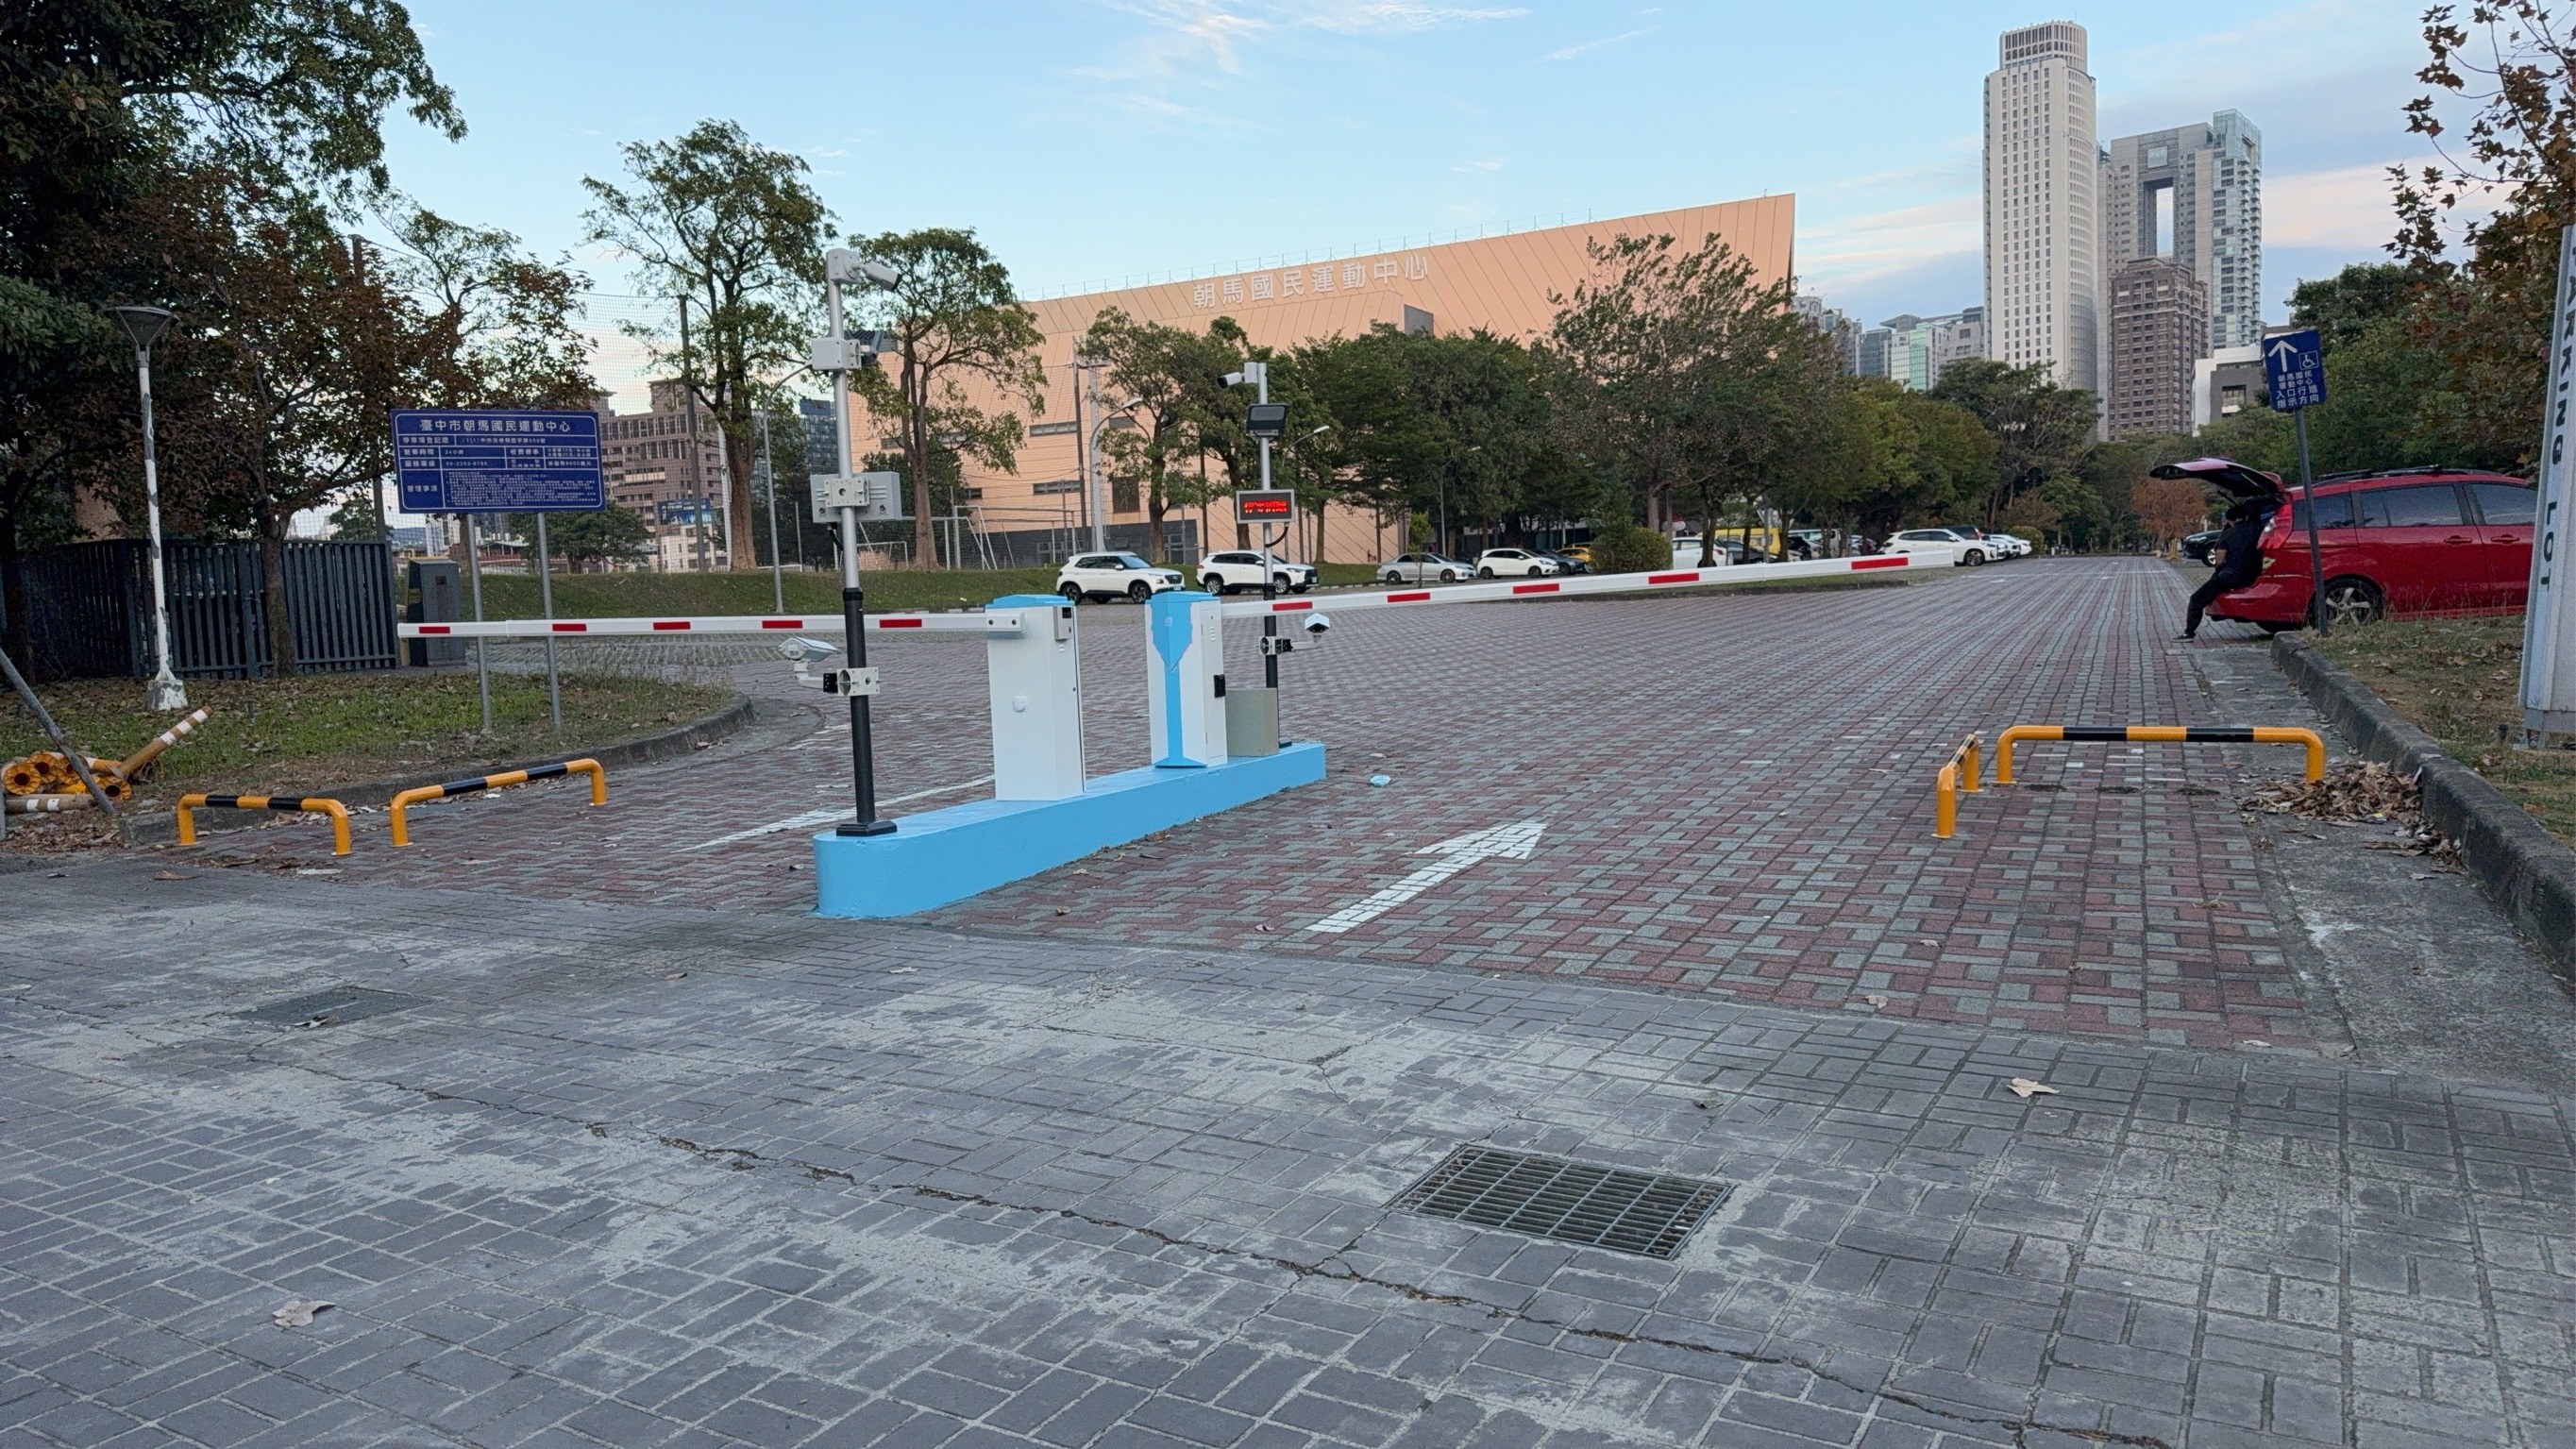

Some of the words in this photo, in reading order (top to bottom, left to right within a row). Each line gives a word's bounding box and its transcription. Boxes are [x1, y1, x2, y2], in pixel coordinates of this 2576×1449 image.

[1193, 254, 1429, 309] 朝馬國民運動中心
[2279, 378, 2314, 390] 運動中心
[2277, 394, 2319, 409] 指示方向
[419, 419, 571, 432] 臺中市朝馬國民運動中心
[2540, 501, 2557, 592] LOT
